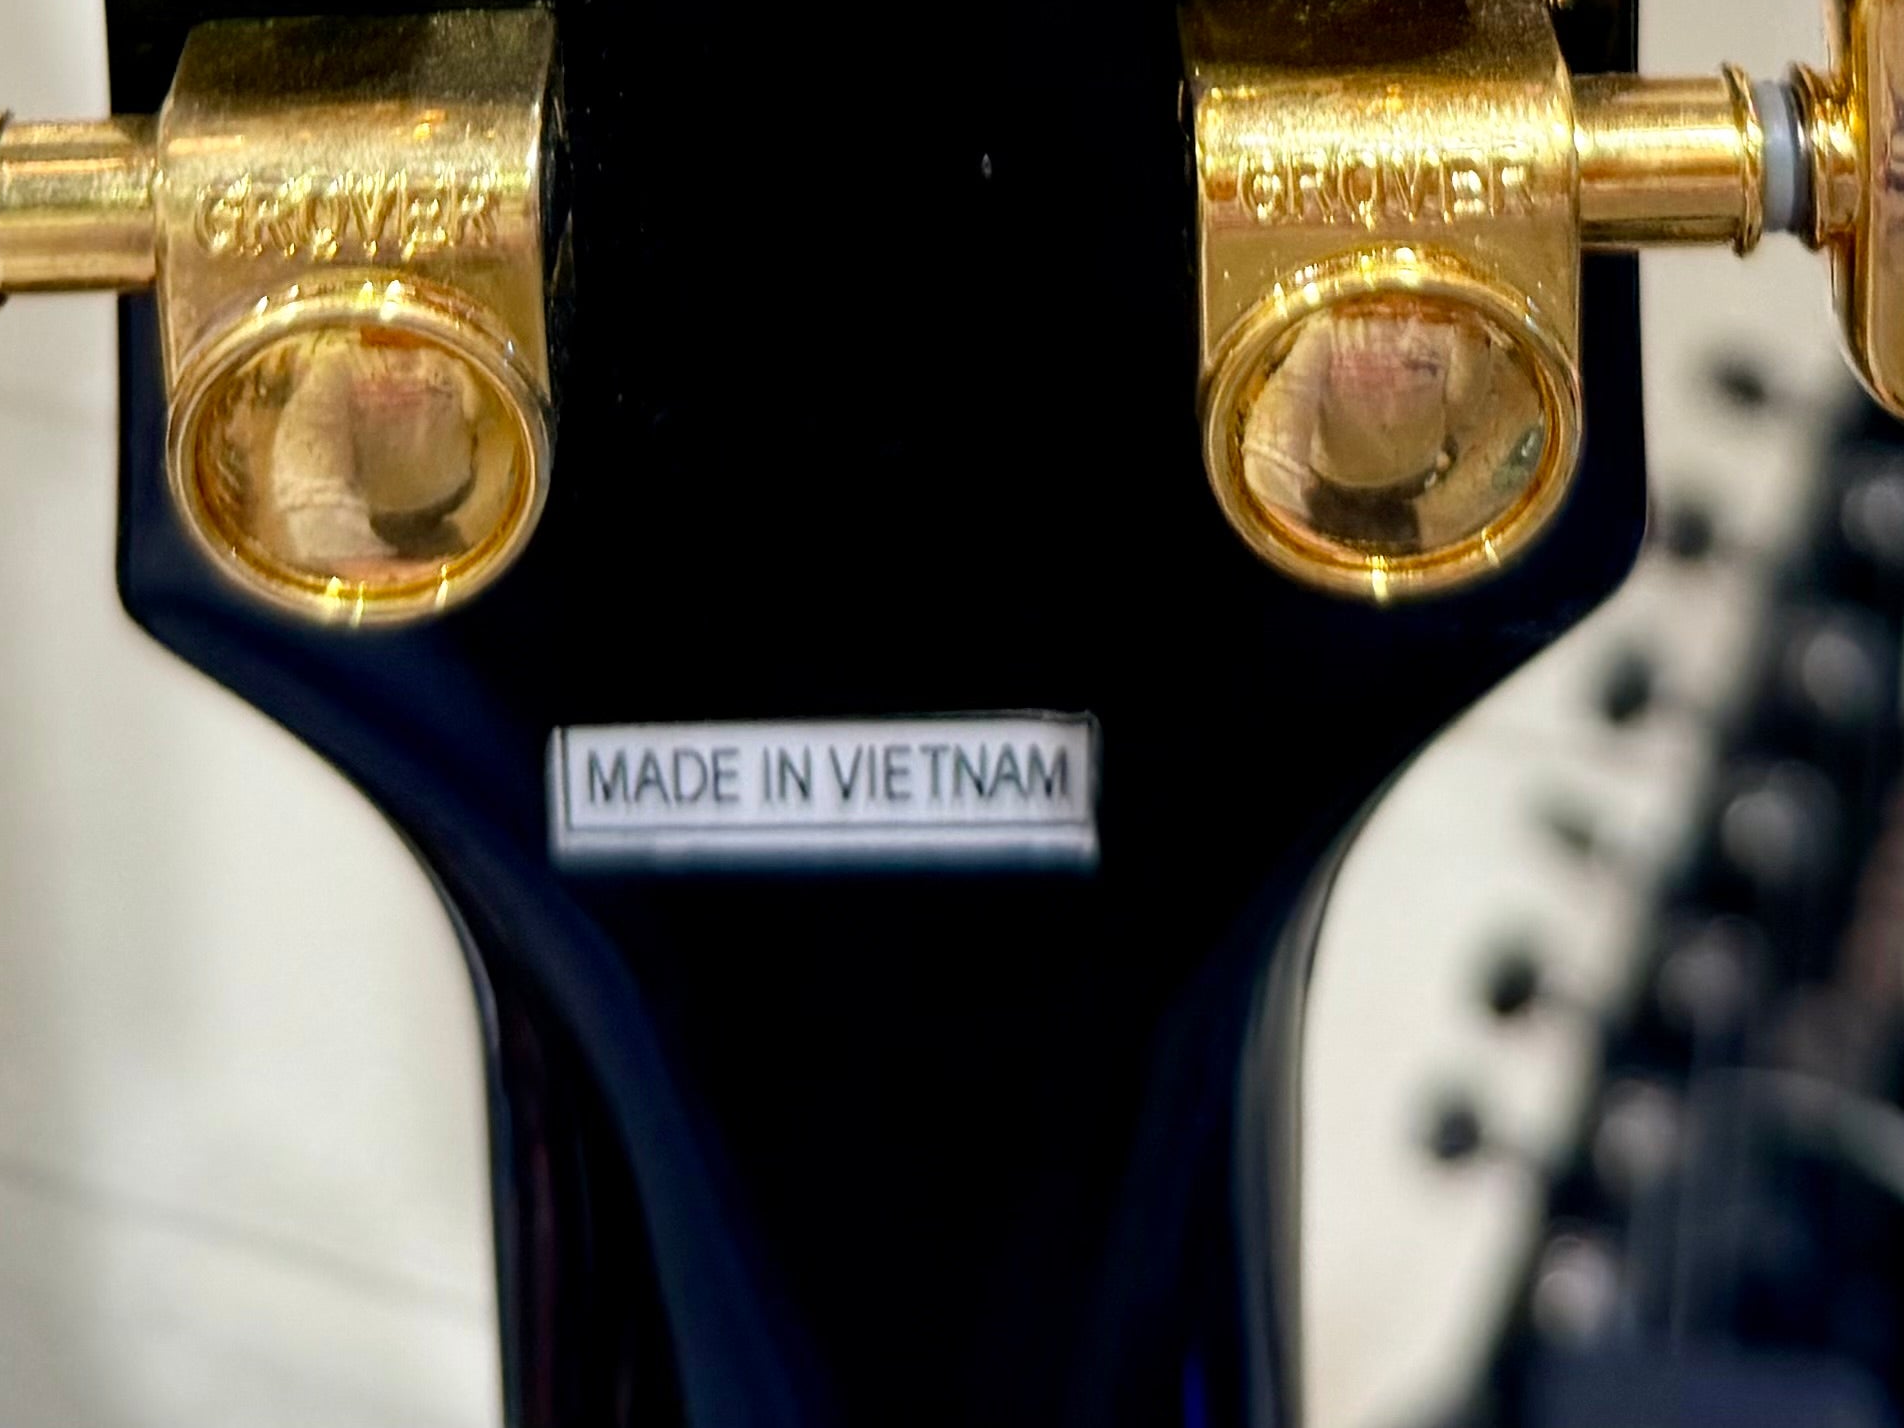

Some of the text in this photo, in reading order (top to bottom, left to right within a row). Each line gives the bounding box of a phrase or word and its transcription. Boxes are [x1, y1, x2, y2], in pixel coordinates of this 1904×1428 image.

[586, 743, 1070, 804] MADE IN VIETNAM
